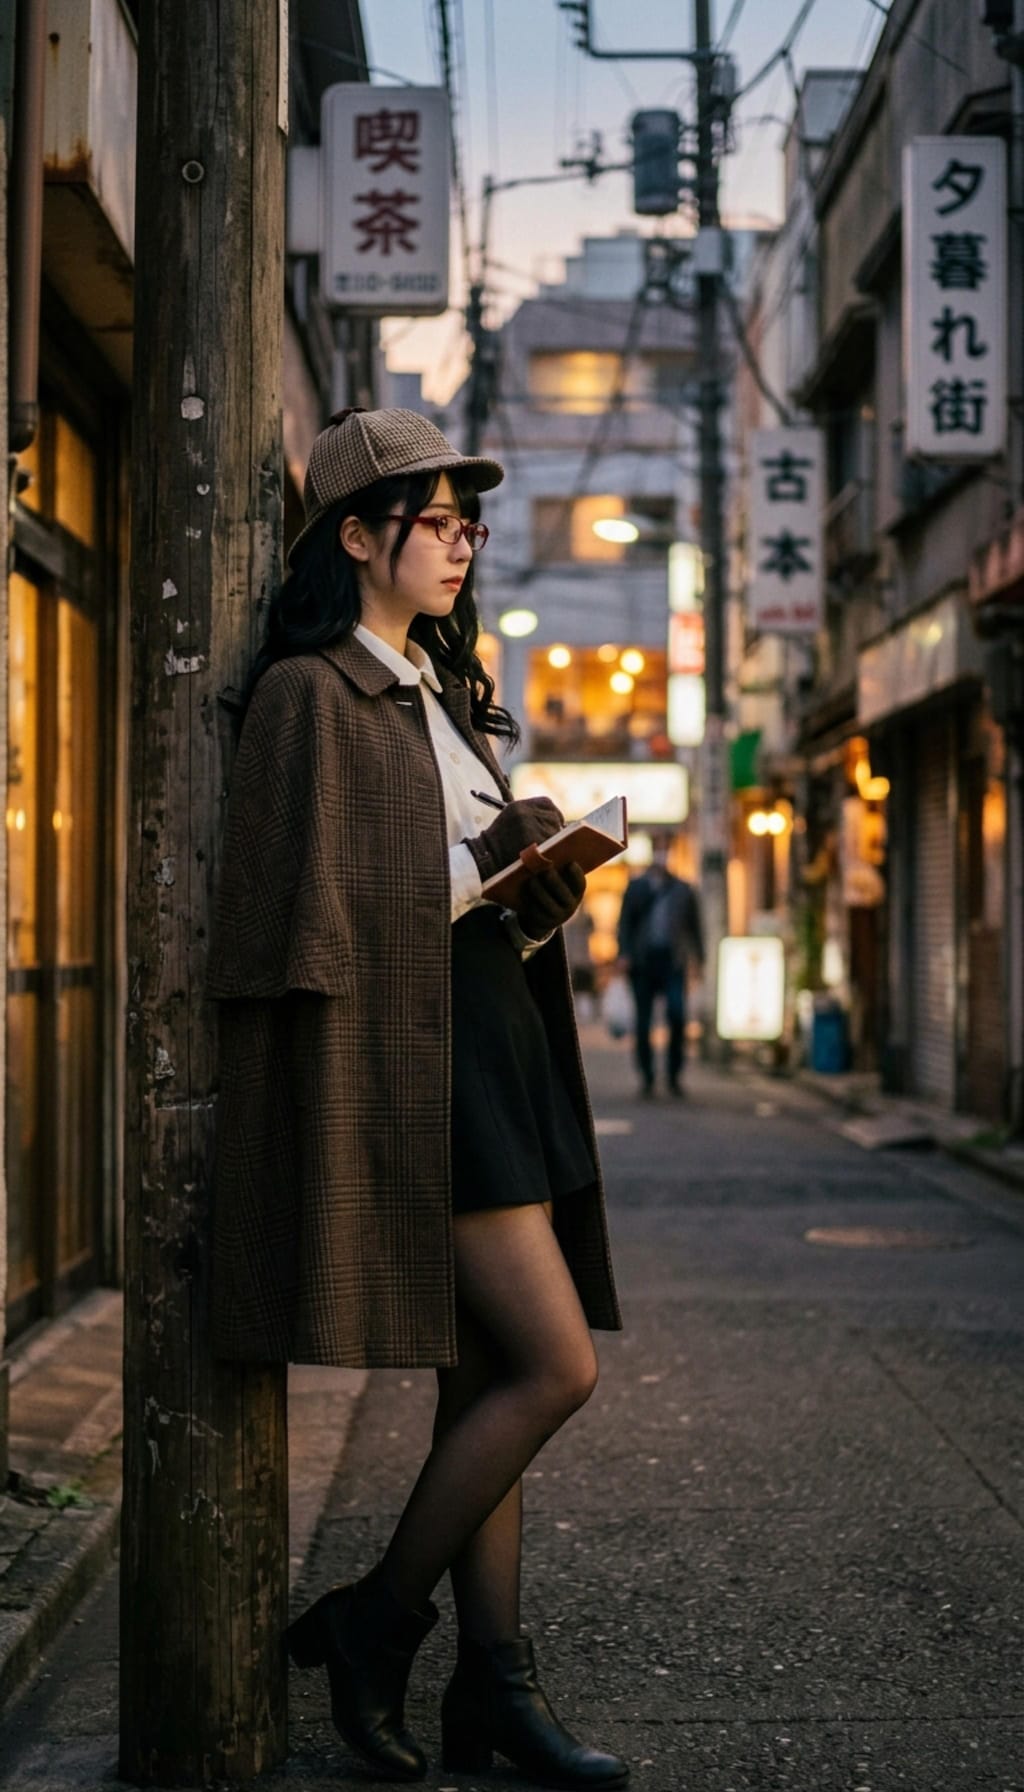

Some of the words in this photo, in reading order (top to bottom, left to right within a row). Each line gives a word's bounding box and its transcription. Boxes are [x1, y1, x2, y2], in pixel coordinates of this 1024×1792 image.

[353, 108, 421, 257] 喫茶
[929, 158, 989, 436] 夕暮れ街
[760, 449, 815, 583] 古本
